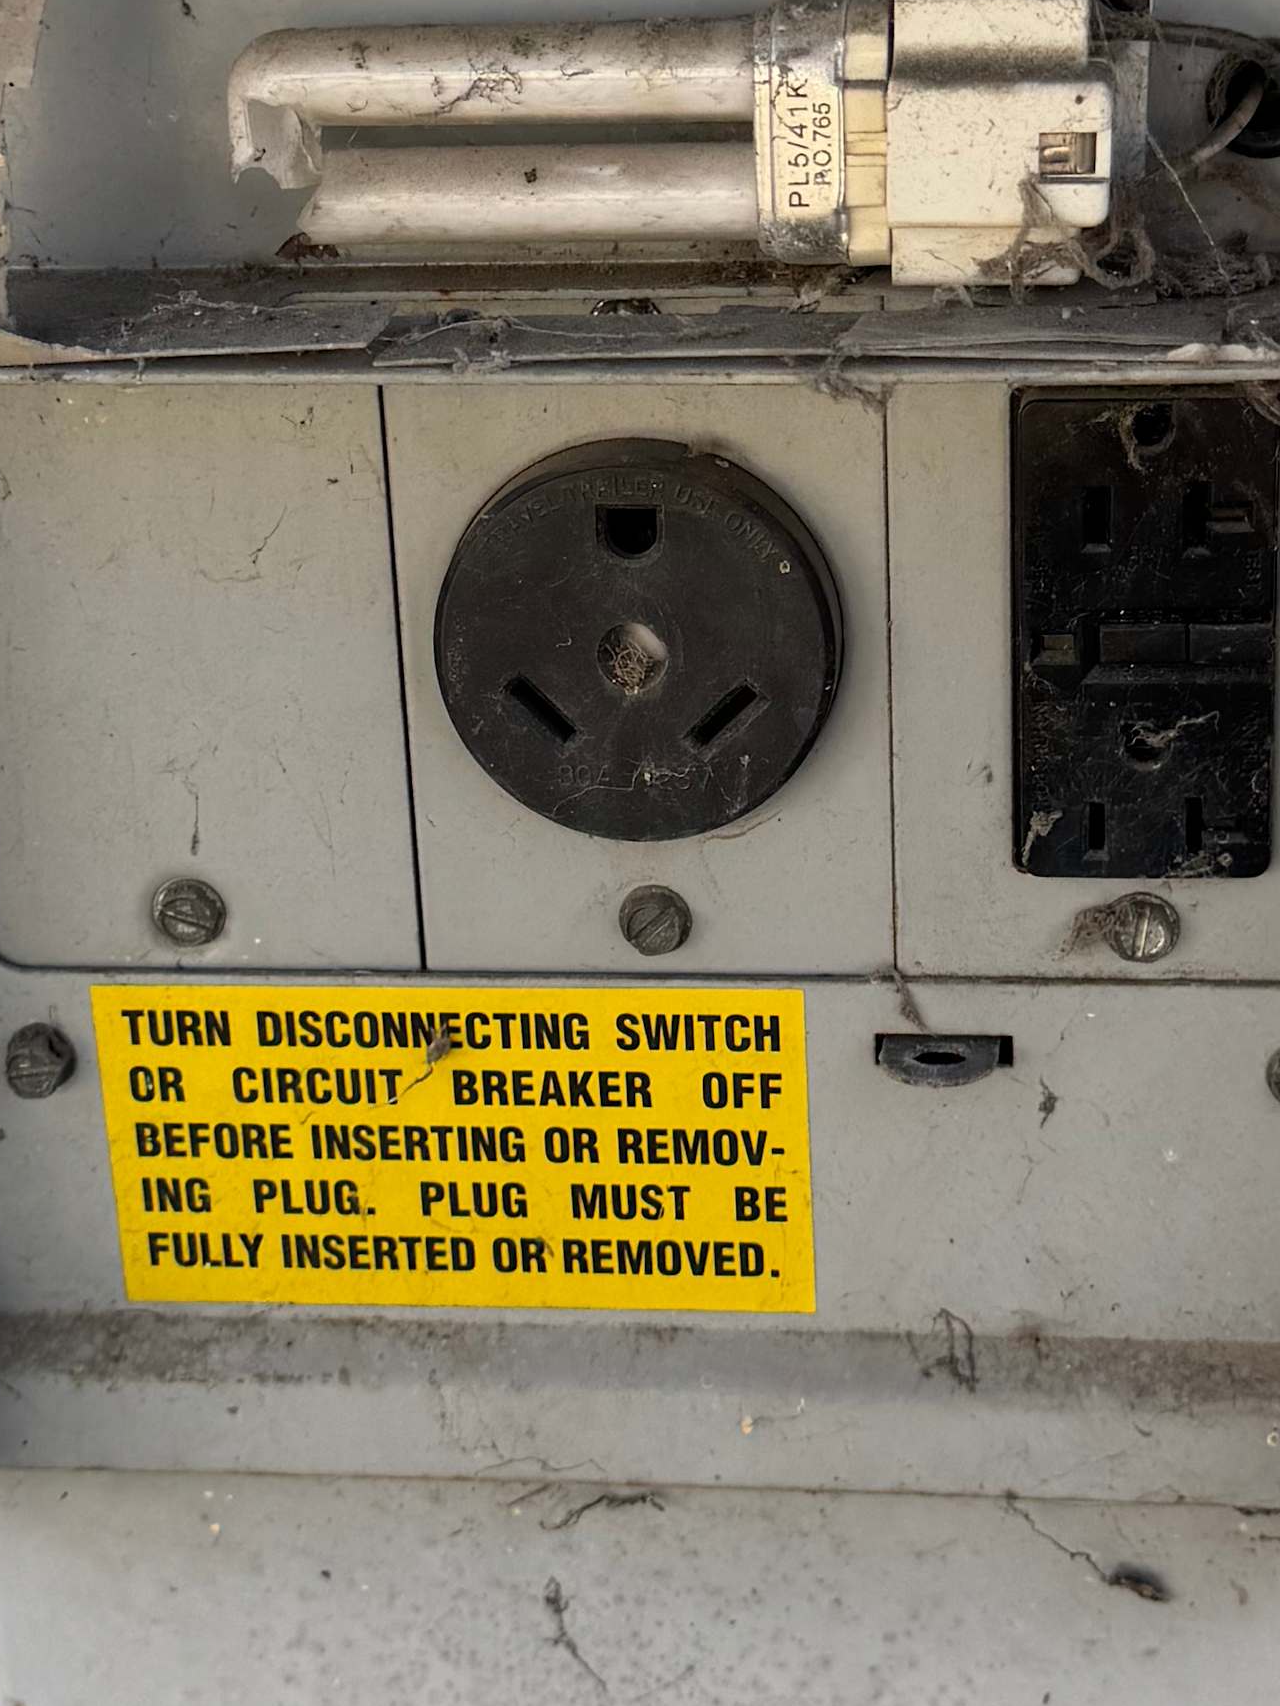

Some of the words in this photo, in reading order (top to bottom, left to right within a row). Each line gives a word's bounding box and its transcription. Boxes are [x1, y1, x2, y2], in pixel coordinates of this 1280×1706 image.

[786, 78, 811, 208] PL5/41K
[121, 1009, 231, 1046] TURN
[256, 1010, 590, 1050] DISCONNECTING
[616, 1012, 781, 1052] SWITCH
[128, 1066, 185, 1103] OR
[231, 1067, 403, 1104] CIRCUIT
[451, 1069, 653, 1108] BREAKER
[701, 1072, 782, 1109] OFF
[135, 1122, 293, 1160] BEFORE
[311, 1124, 526, 1163] INSERTING
[544, 1127, 600, 1164] OR
[617, 1128, 785, 1166] REMOV-
[141, 1177, 212, 1213] ING
[252, 1179, 376, 1215] PLUG.
[419, 1181, 528, 1219] PLUG
[569, 1183, 691, 1221] MUST
[734, 1186, 788, 1223] BE
[147, 1232, 264, 1268] FULLY
[281, 1234, 476, 1272] INSERTED
[492, 1237, 547, 1274] OR
[562, 1238, 781, 1278] REMOVED.
